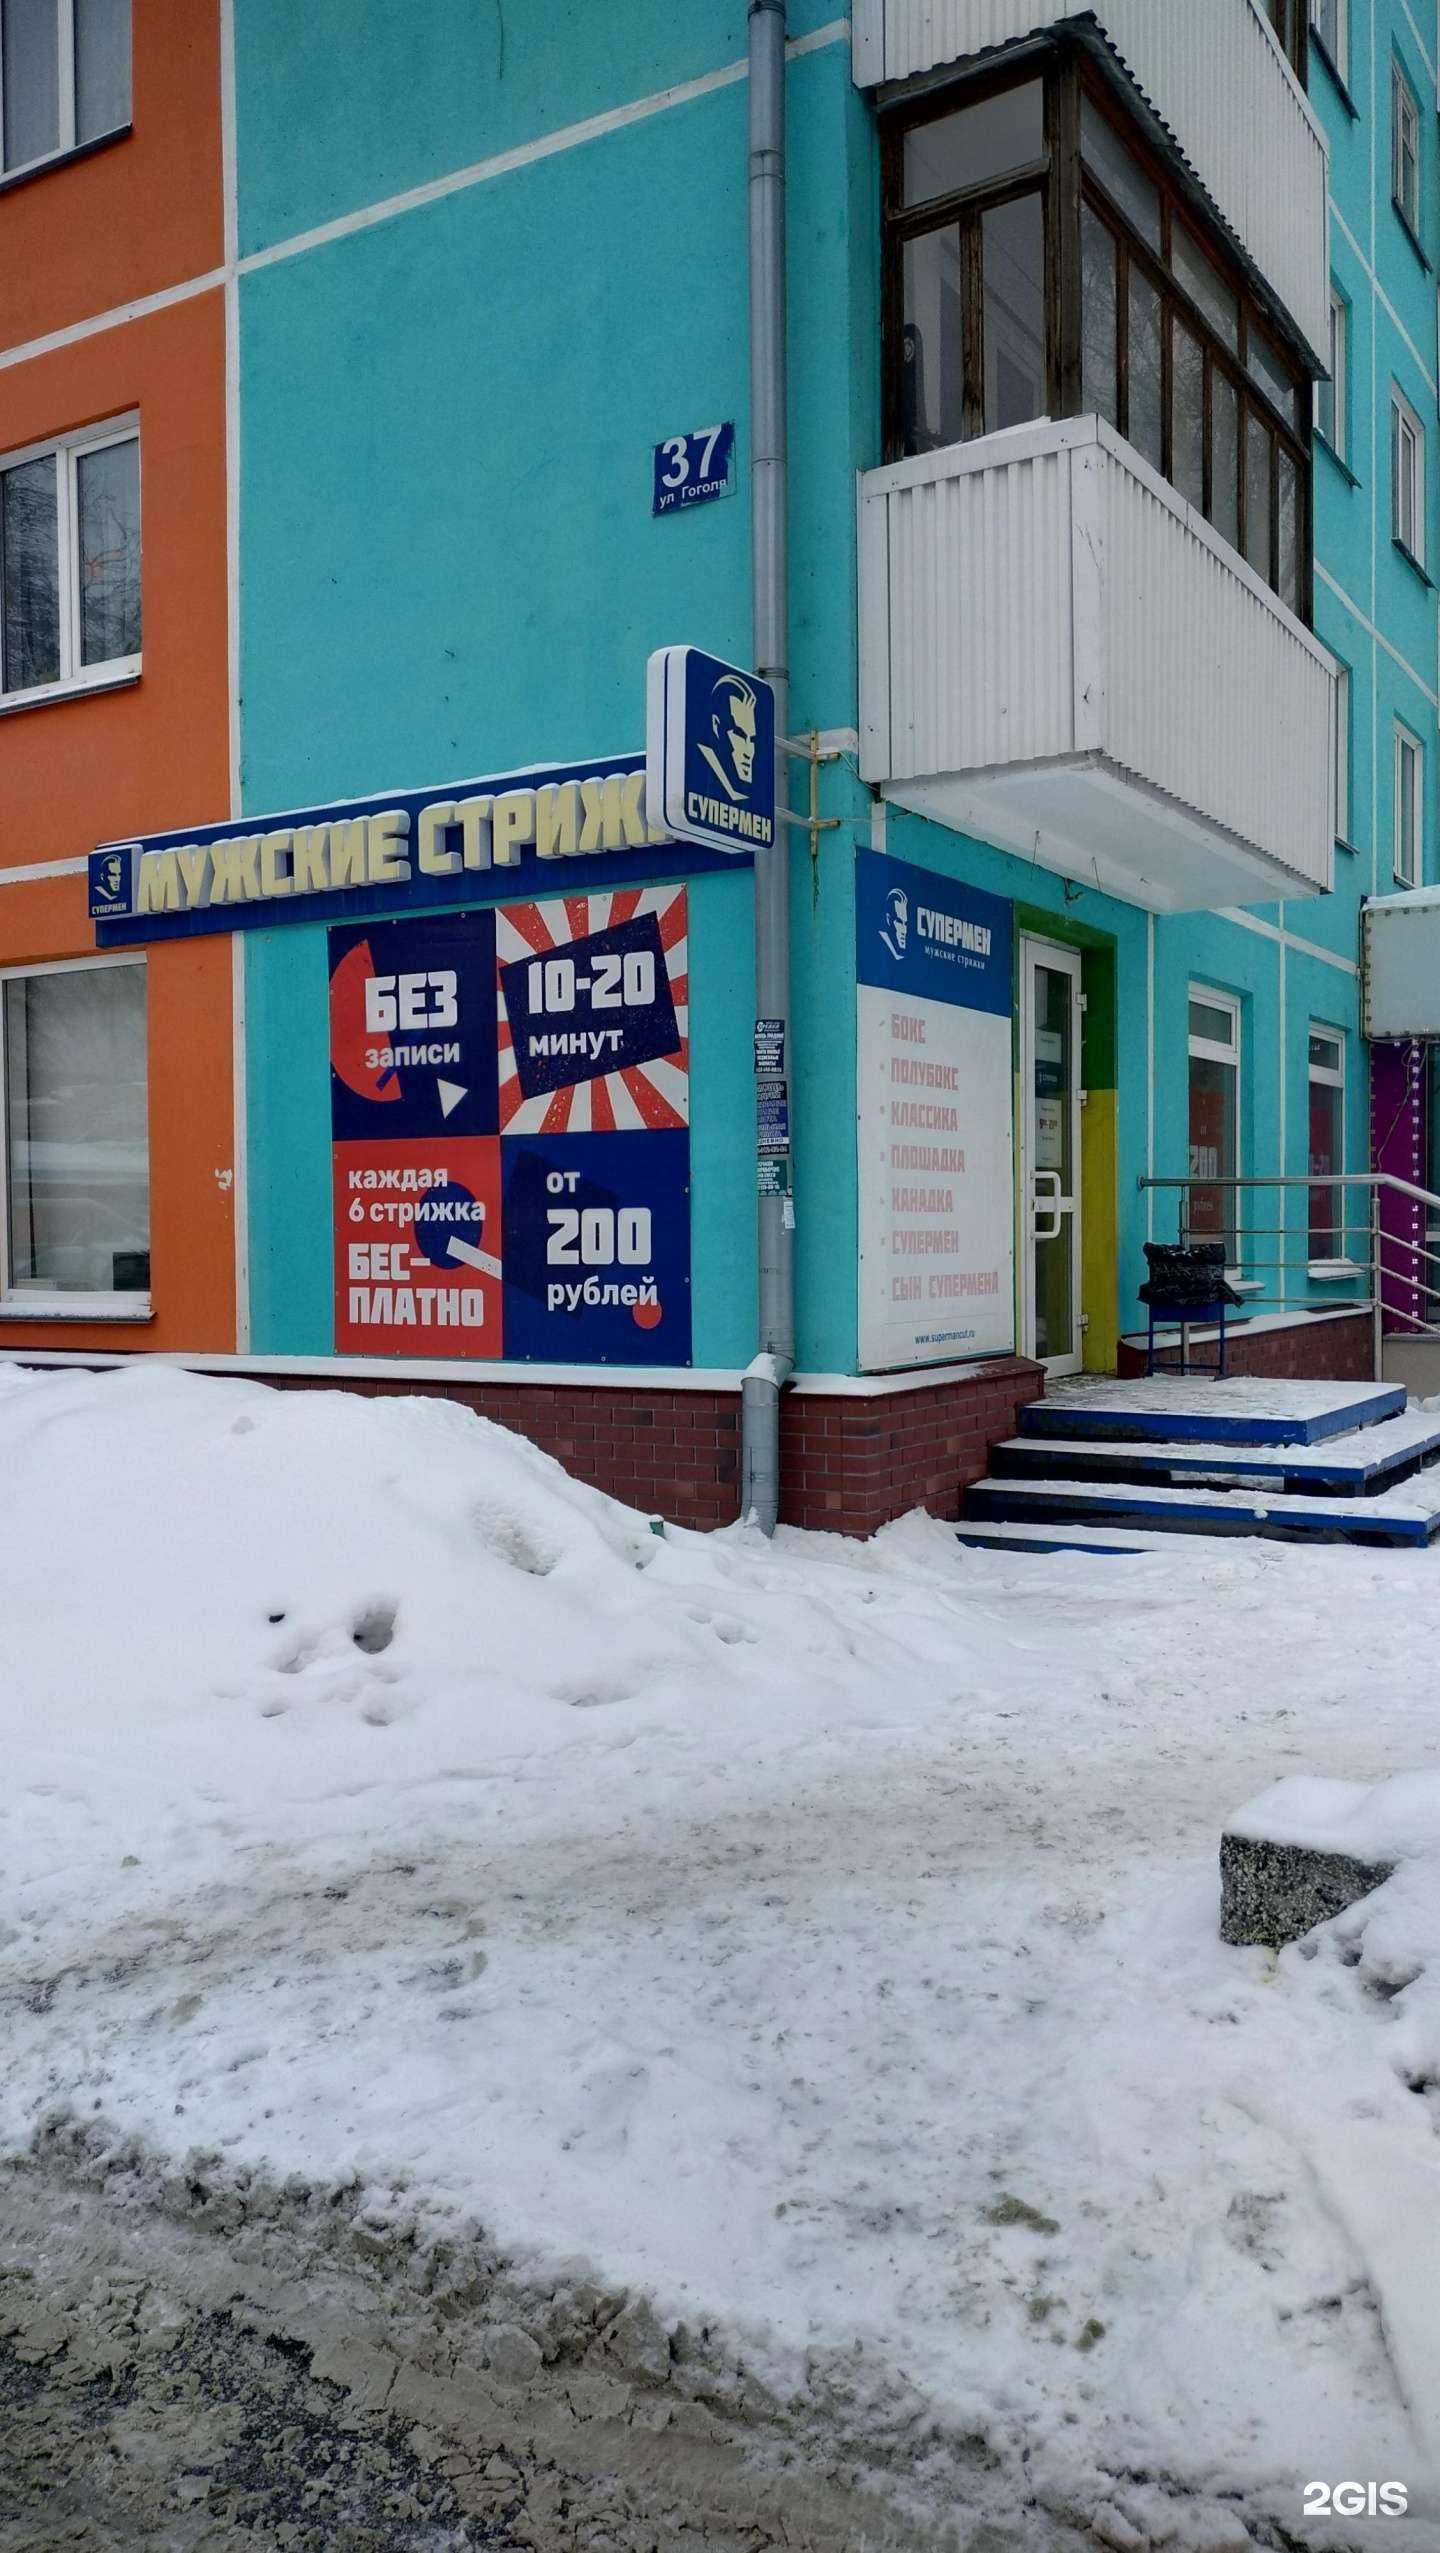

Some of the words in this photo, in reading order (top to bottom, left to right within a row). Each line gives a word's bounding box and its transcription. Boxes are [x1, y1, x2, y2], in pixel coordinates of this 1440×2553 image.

[662, 425, 722, 488] 37
[660, 493, 675, 509] ул
[681, 479, 727, 499] Гоголя
[687, 791, 772, 843] СУПЕРМЕН
[137, 810, 411, 914] МУЖСКИЕ
[418, 769, 678, 876] СТРИЖ
[91, 902, 127, 914] СУПЕРМЕН
[916, 906, 992, 956] СУПЕРМЕН
[925, 945, 955, 962] мужские
[957, 953, 985, 970] стрижки
[528, 951, 655, 1015] 10-20
[365, 970, 458, 1033] БЕЗ
[891, 1013, 926, 1044] БОКС
[365, 1042, 460, 1069] записи
[529, 1030, 624, 1059] минут
[891, 1057, 959, 1091] ПОЛУБОКС
[891, 1101, 958, 1131] КЛАССИКА
[348, 1168, 448, 1190] каждая
[546, 1171, 580, 1193] от
[348, 1198, 365, 1222] 6
[370, 1200, 487, 1227] стрижка
[892, 1187, 953, 1212] КАНАДКА
[547, 1207, 652, 1265] 200
[892, 1230, 959, 1255] СУПЕРМЕН
[348, 1243, 431, 1281] БЕС-
[547, 1276, 658, 1311] рублей
[892, 1276, 922, 1301] СЫН
[929, 1271, 999, 1298] СУПЕРМЕНА
[348, 1287, 484, 1327] ПЛАТНО
[914, 1329, 976, 1345] www.supermancut.ru
